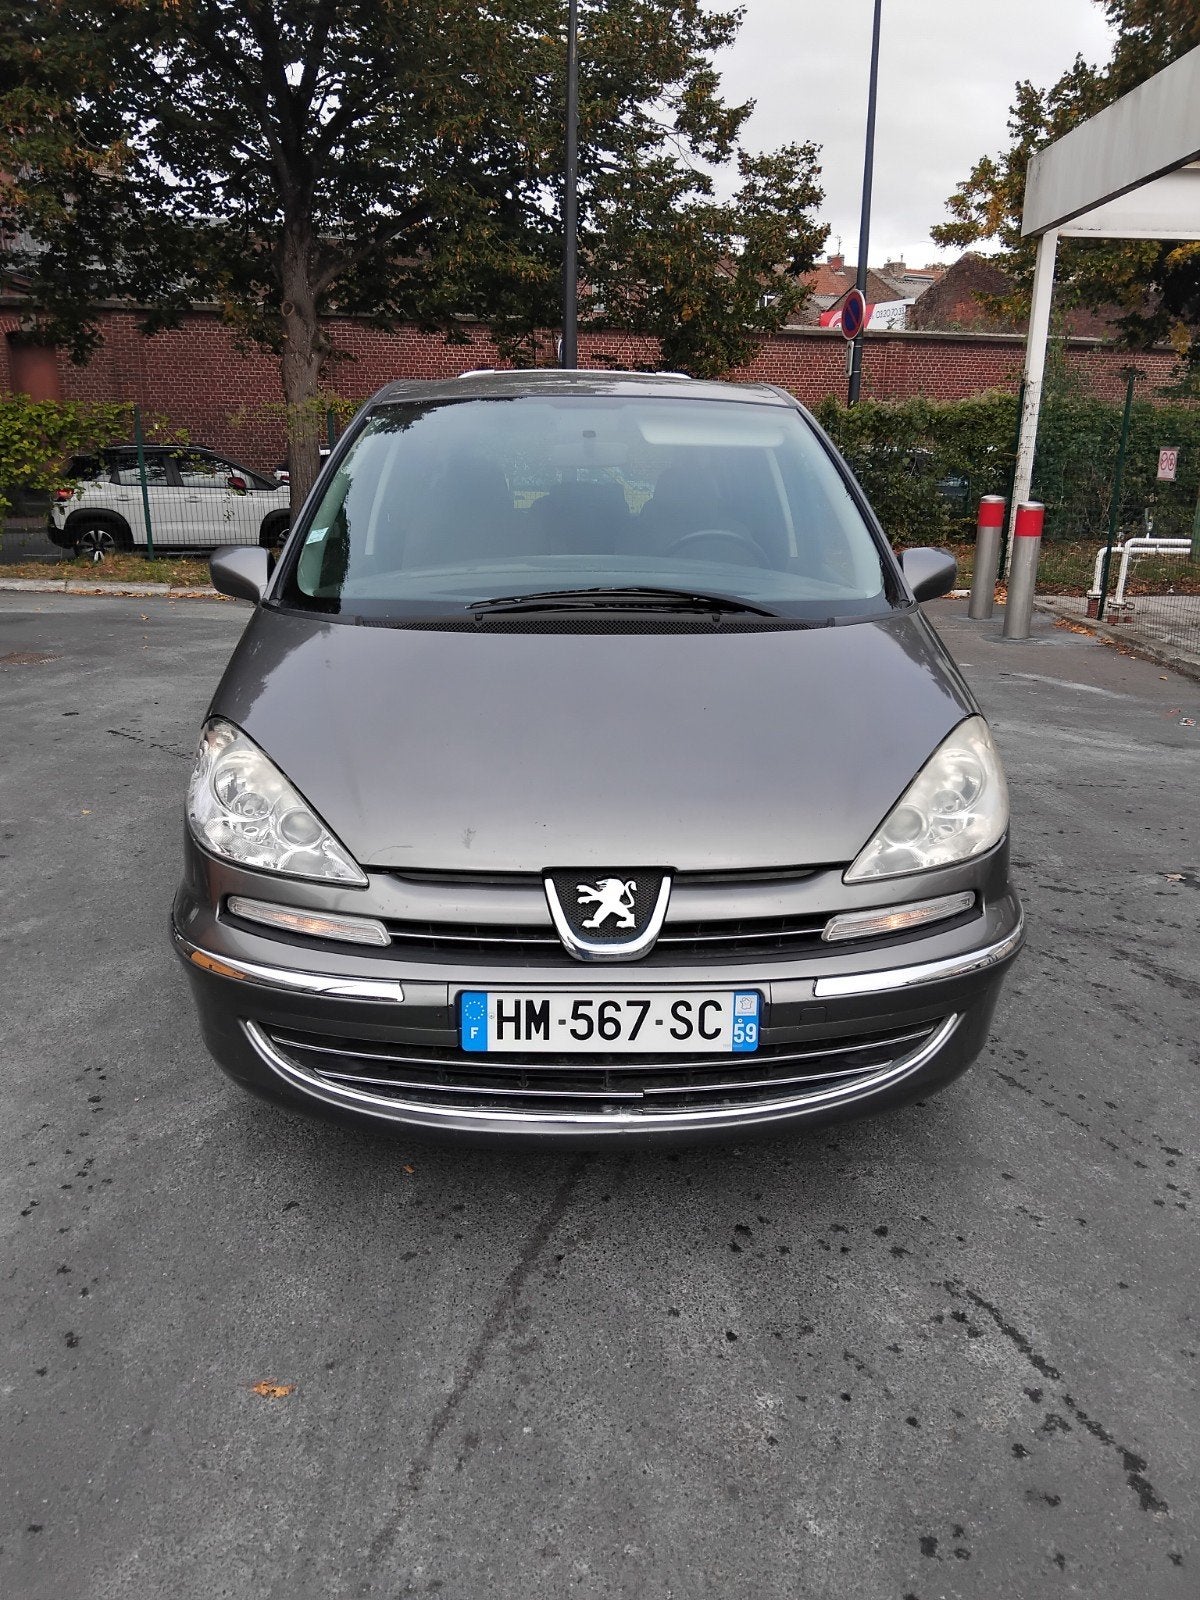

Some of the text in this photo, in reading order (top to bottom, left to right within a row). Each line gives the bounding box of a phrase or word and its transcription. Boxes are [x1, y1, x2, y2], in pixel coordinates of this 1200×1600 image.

[496, 999, 722, 1041] HM-567-SC
[470, 1026, 479, 1039] F
[733, 1023, 757, 1043] 59
